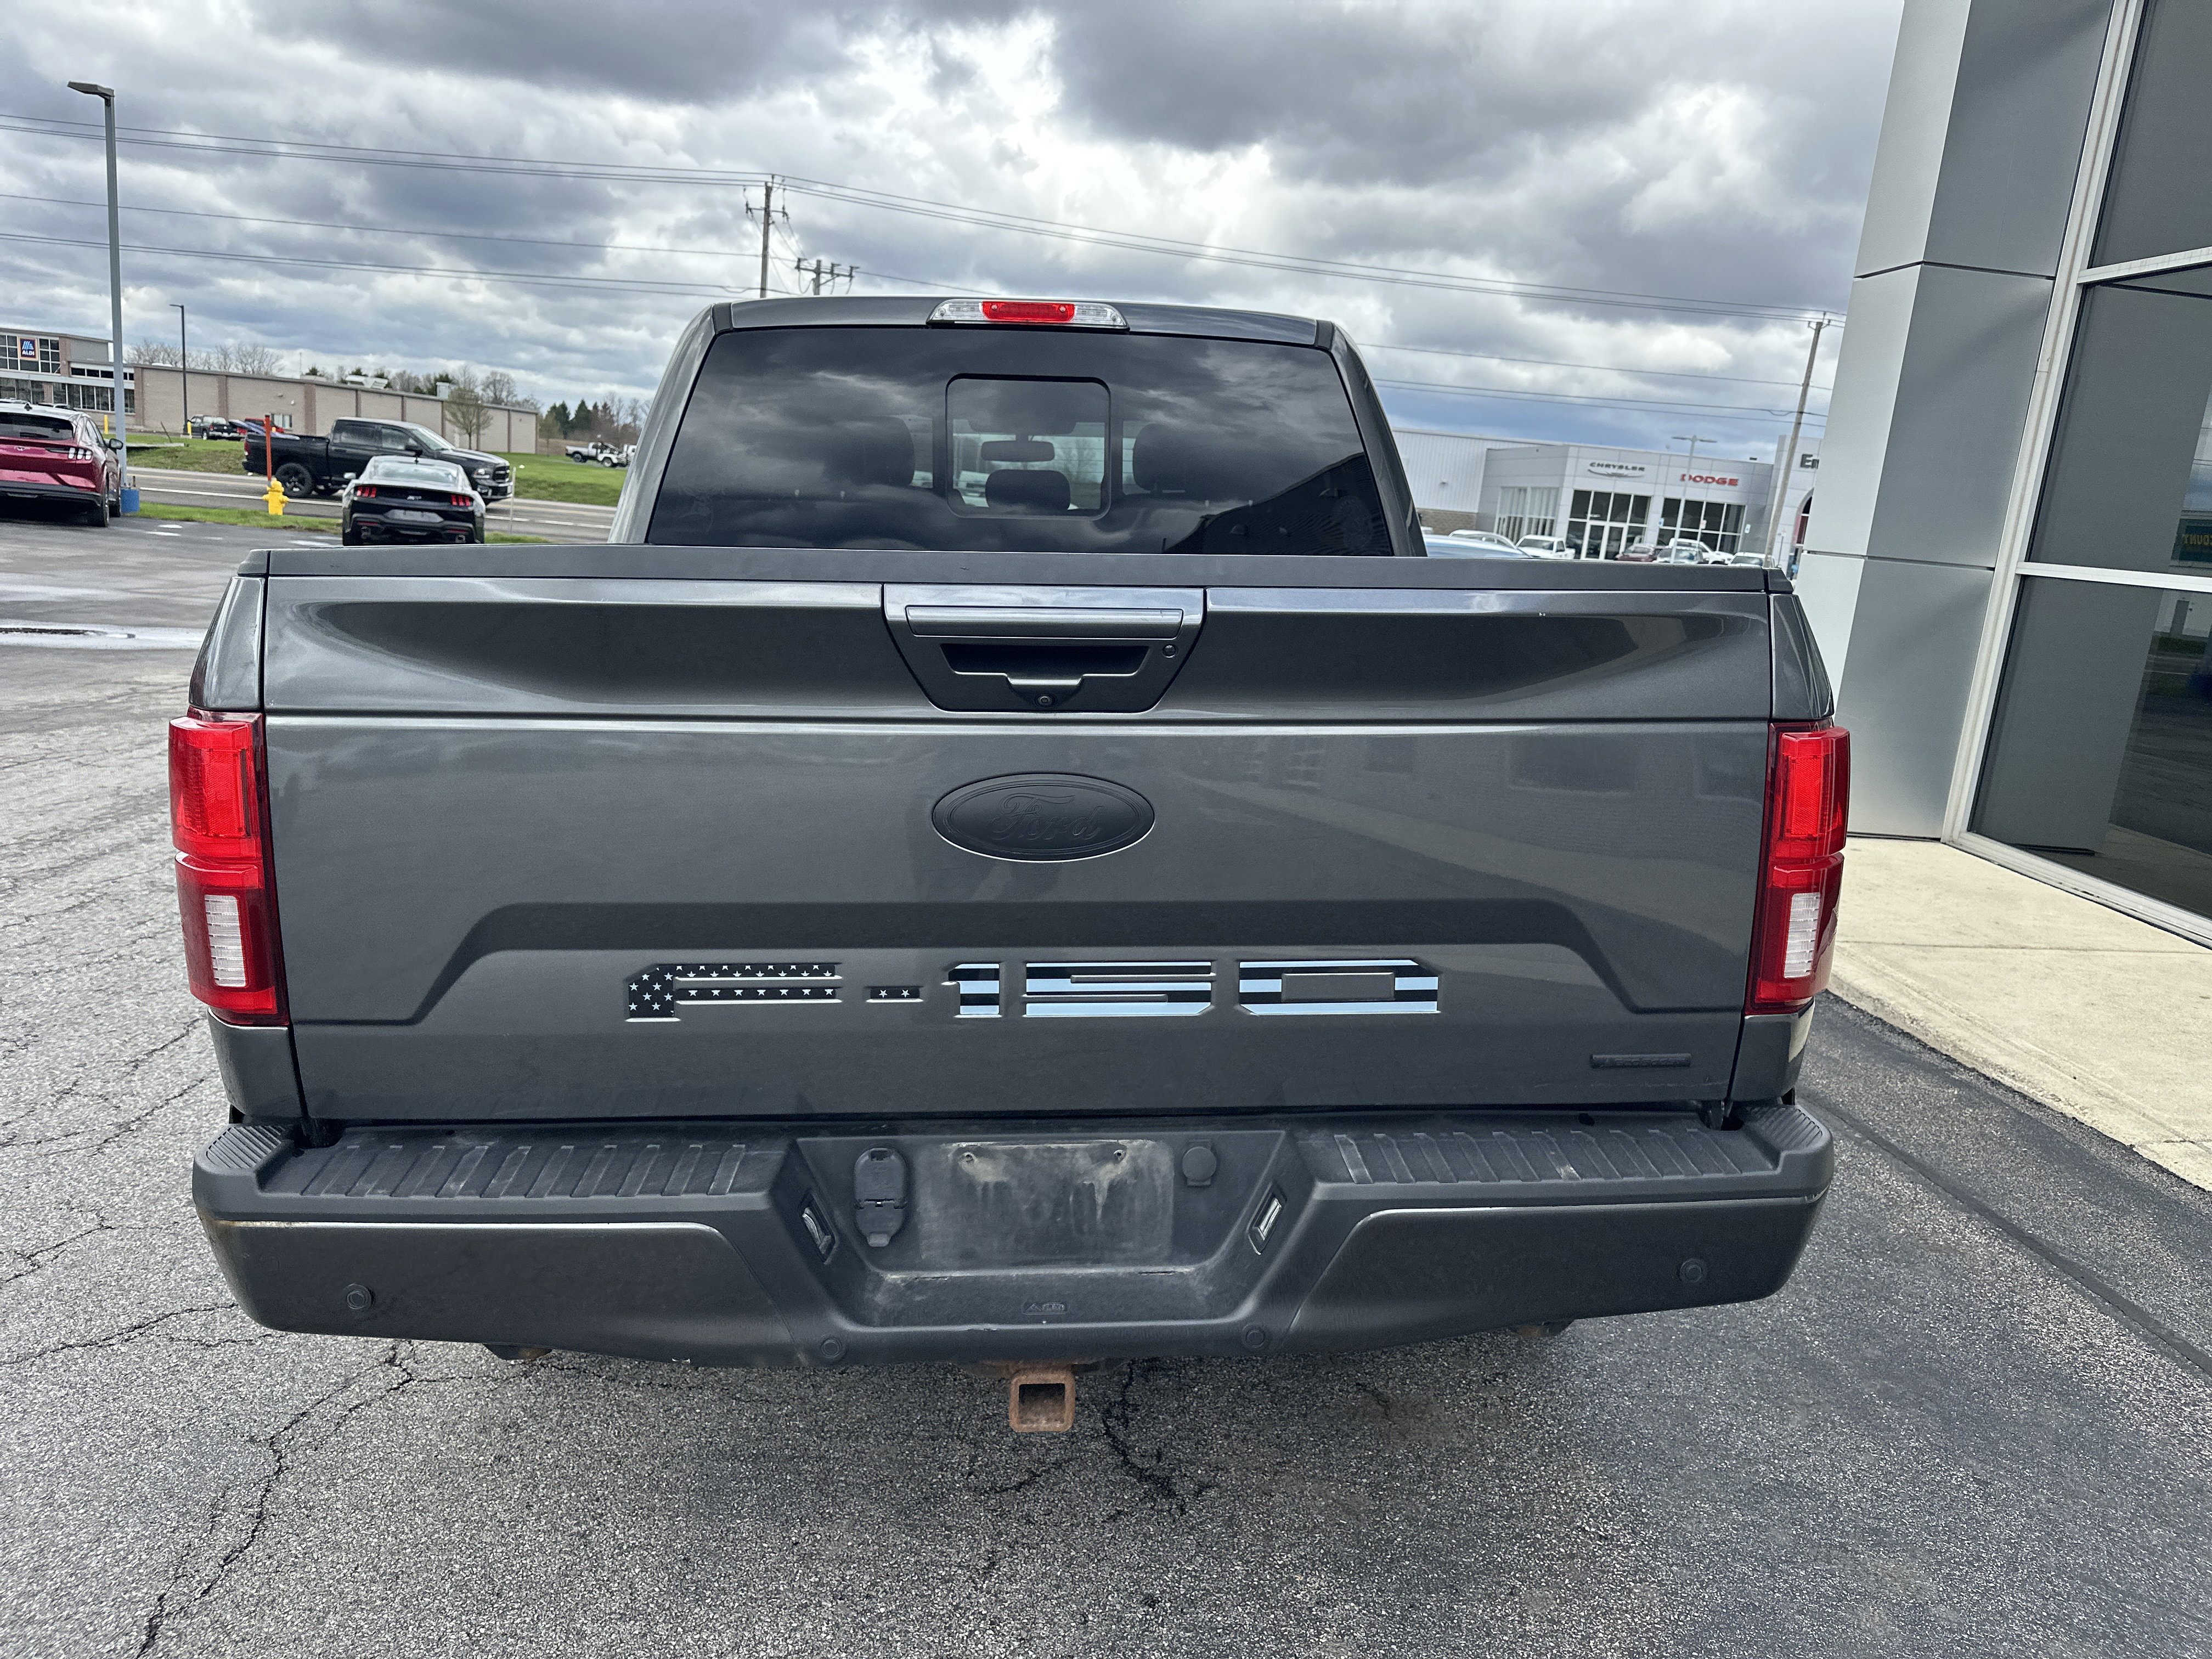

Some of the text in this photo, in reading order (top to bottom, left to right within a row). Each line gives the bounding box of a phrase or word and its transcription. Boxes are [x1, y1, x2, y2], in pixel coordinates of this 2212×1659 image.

[1589, 462, 1645, 472] CHRYSLER
[1680, 473, 1739, 487] DODGE
[988, 792, 1105, 840] Ford
[624, 958, 1441, 1022] F-150
